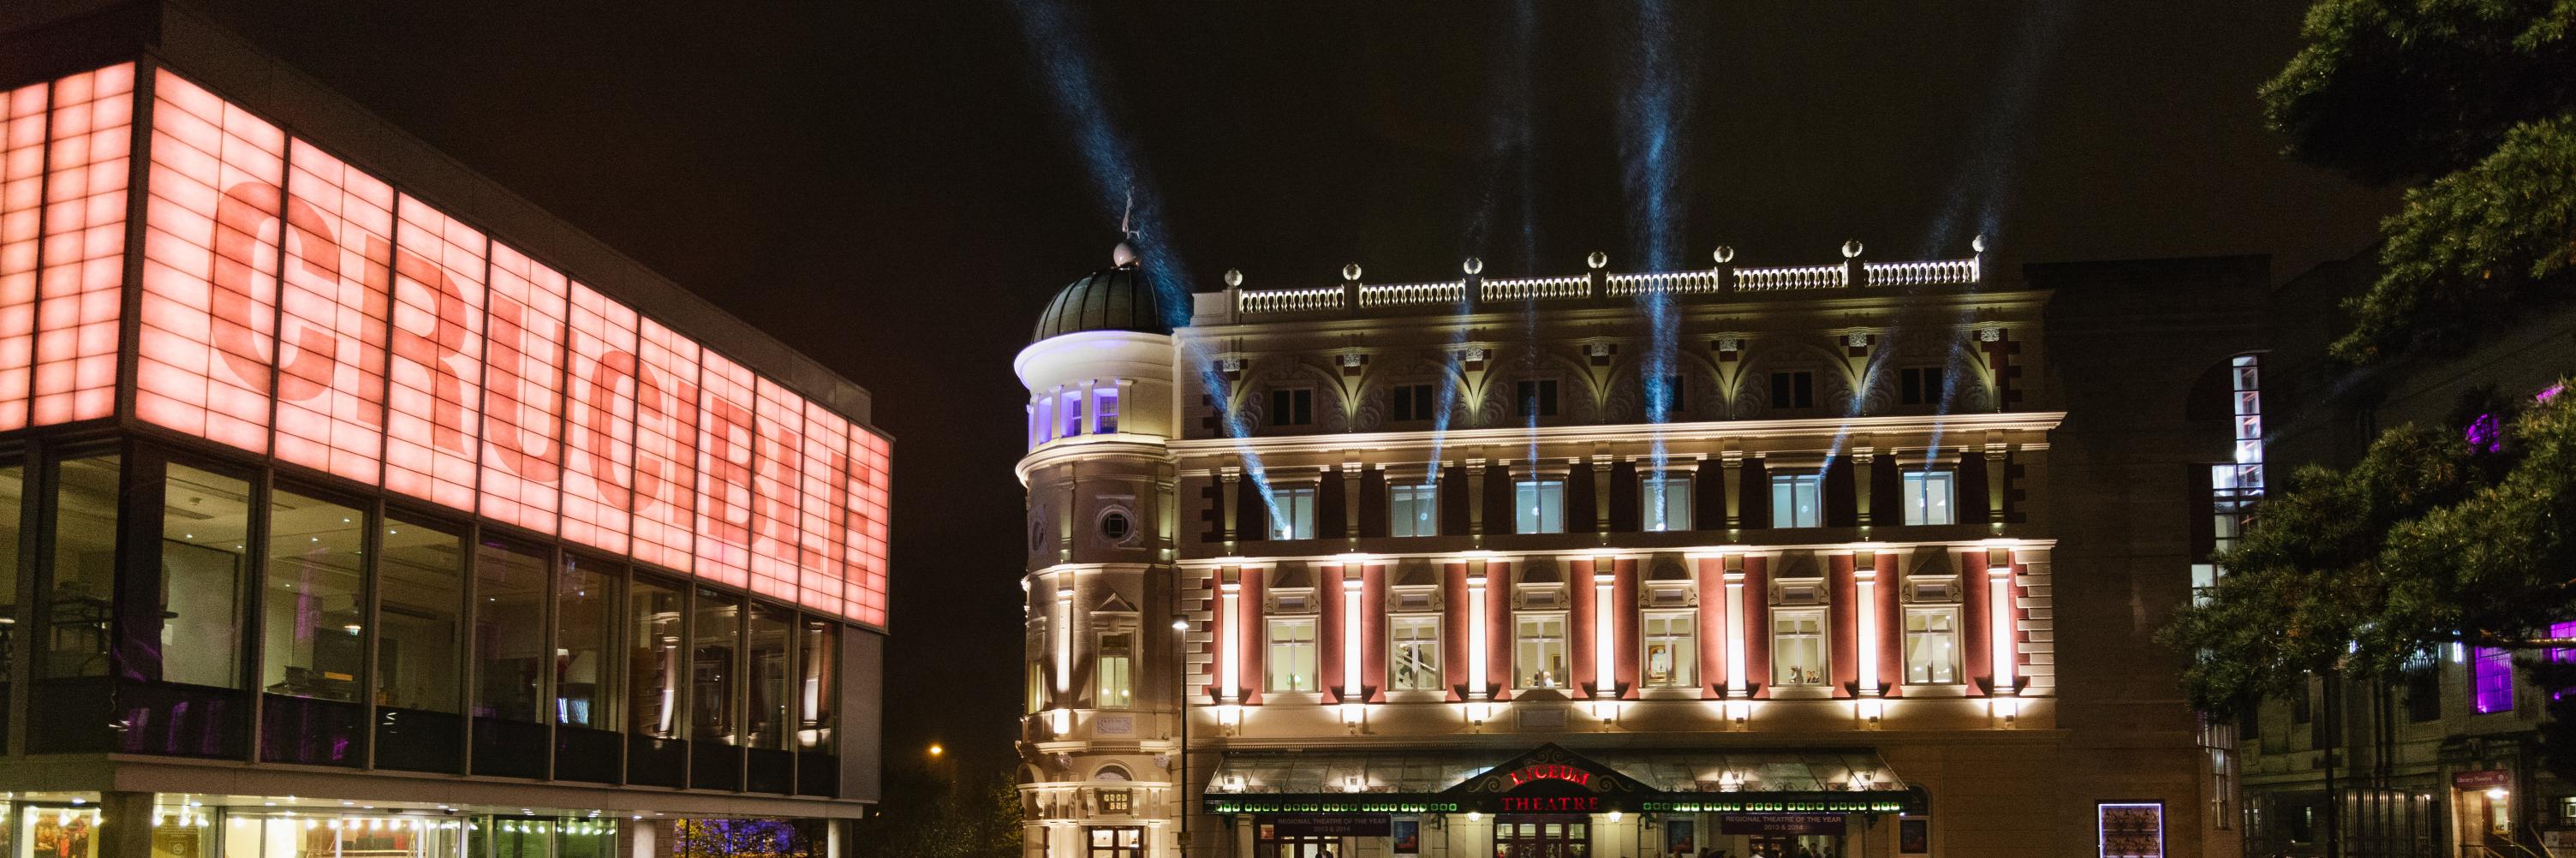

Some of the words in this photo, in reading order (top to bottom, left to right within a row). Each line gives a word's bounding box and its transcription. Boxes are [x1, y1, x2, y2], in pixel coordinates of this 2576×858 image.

[209, 181, 871, 587] CRUCIBLE
[1510, 764, 1590, 786] LYCEUM
[1500, 797, 1599, 811] THEATRE
